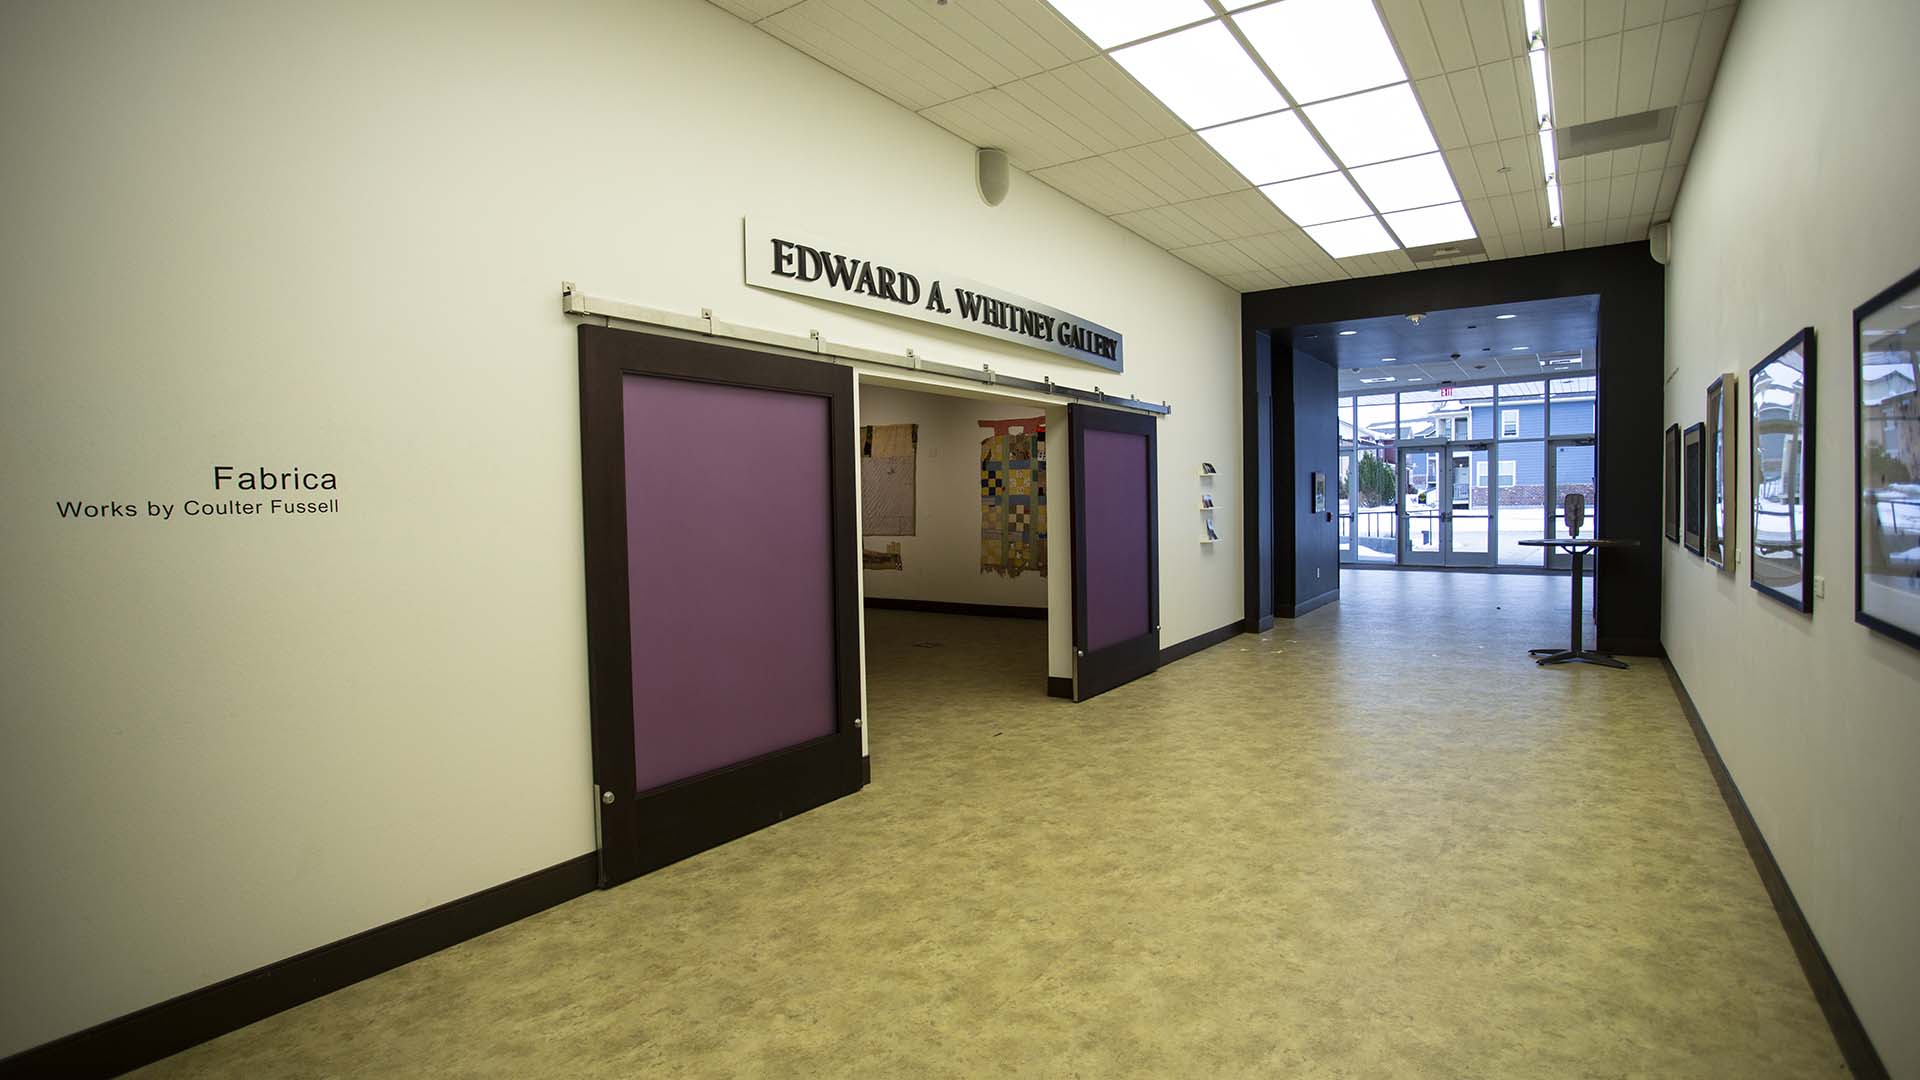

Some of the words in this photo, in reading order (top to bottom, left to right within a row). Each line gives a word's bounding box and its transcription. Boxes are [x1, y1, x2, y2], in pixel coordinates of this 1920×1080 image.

[771, 238, 920, 305] EDWARD
[925, 280, 952, 314] A.
[956, 288, 1054, 341] WHITNEY
[1057, 321, 1118, 361] GALLERY
[1440, 387, 1453, 397] EXIT
[214, 466, 338, 490] Fabrica
[56, 500, 138, 518] Works
[147, 501, 175, 520] by
[183, 500, 263, 516] Coulter
[270, 499, 339, 514] Fussell
